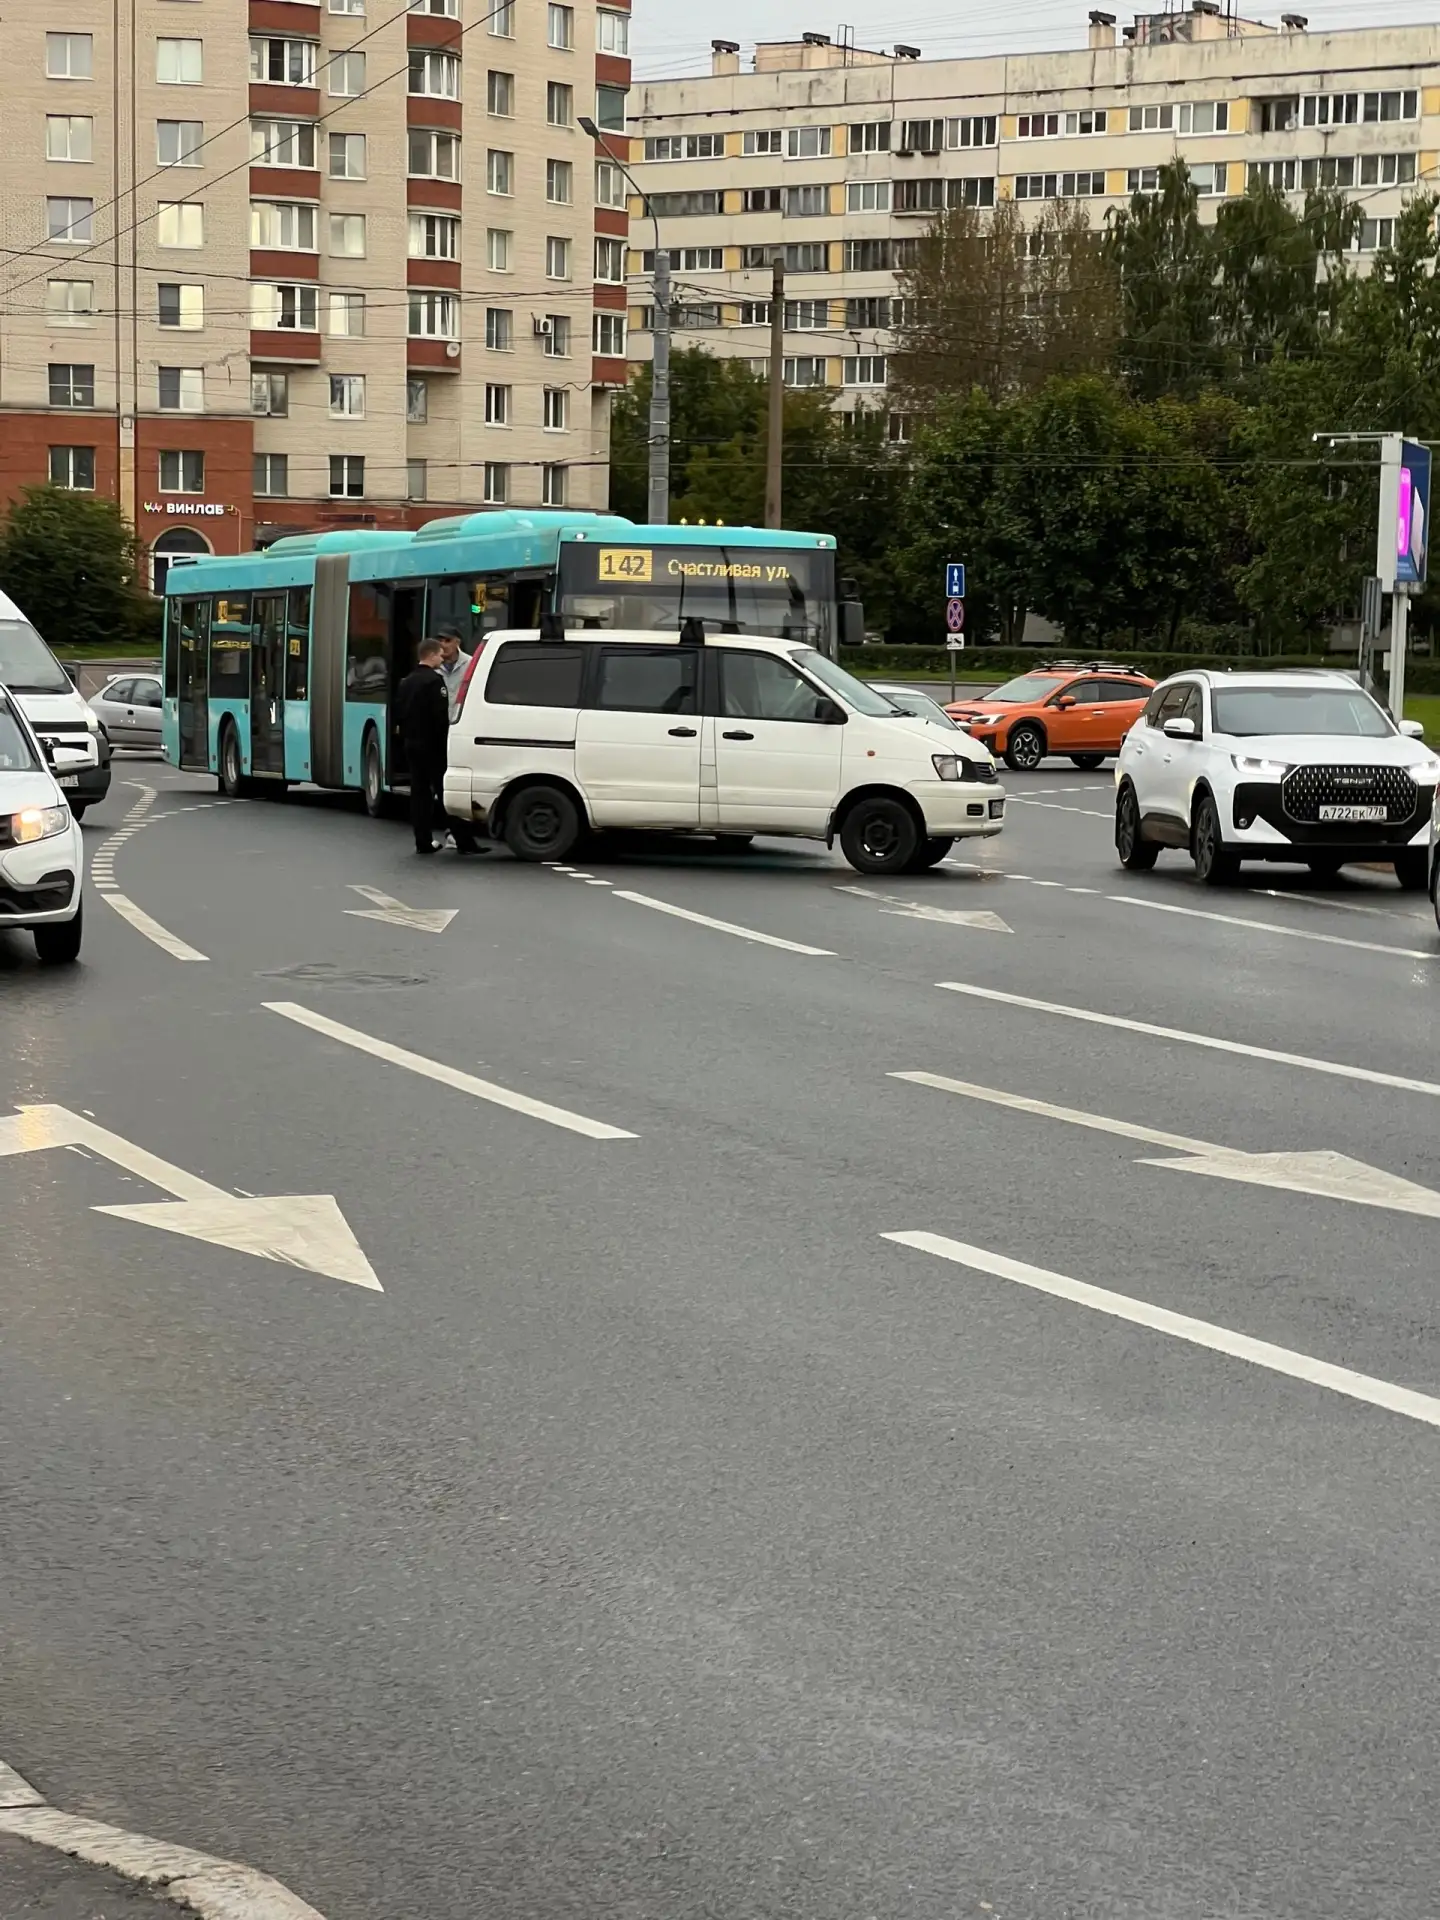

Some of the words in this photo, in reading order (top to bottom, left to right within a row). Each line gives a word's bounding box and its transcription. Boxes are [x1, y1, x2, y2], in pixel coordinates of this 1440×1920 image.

[604, 555, 646, 577] 142
[667, 559, 761, 578] Счастливая
[765, 565, 790, 582] ул.
